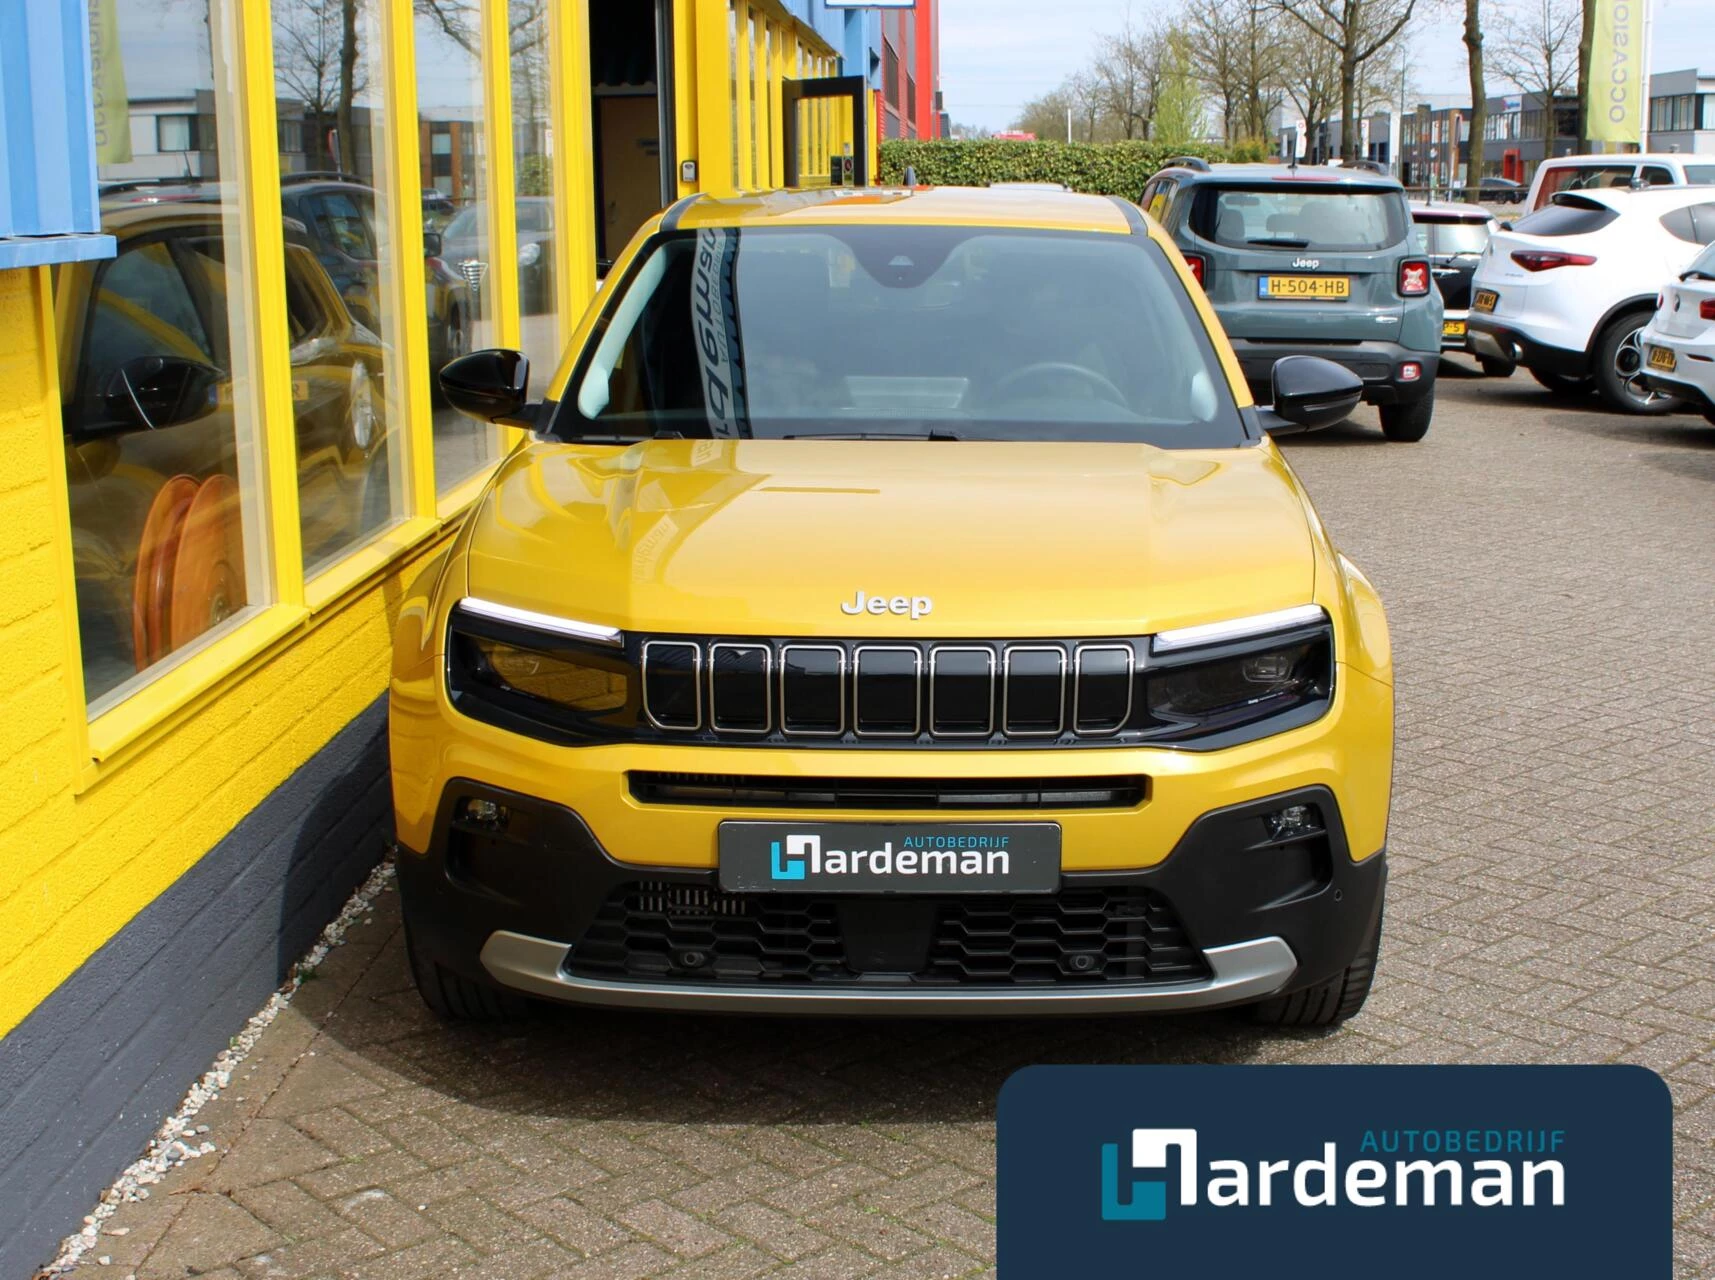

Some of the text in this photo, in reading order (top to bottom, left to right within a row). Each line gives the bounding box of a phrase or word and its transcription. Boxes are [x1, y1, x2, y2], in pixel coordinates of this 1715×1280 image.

[1292, 258, 1320, 269] Jeep
[1271, 279, 1345, 294] H-504-HB
[841, 591, 933, 620] Jeep
[903, 836, 1009, 848] AUTOBEDRIJF
